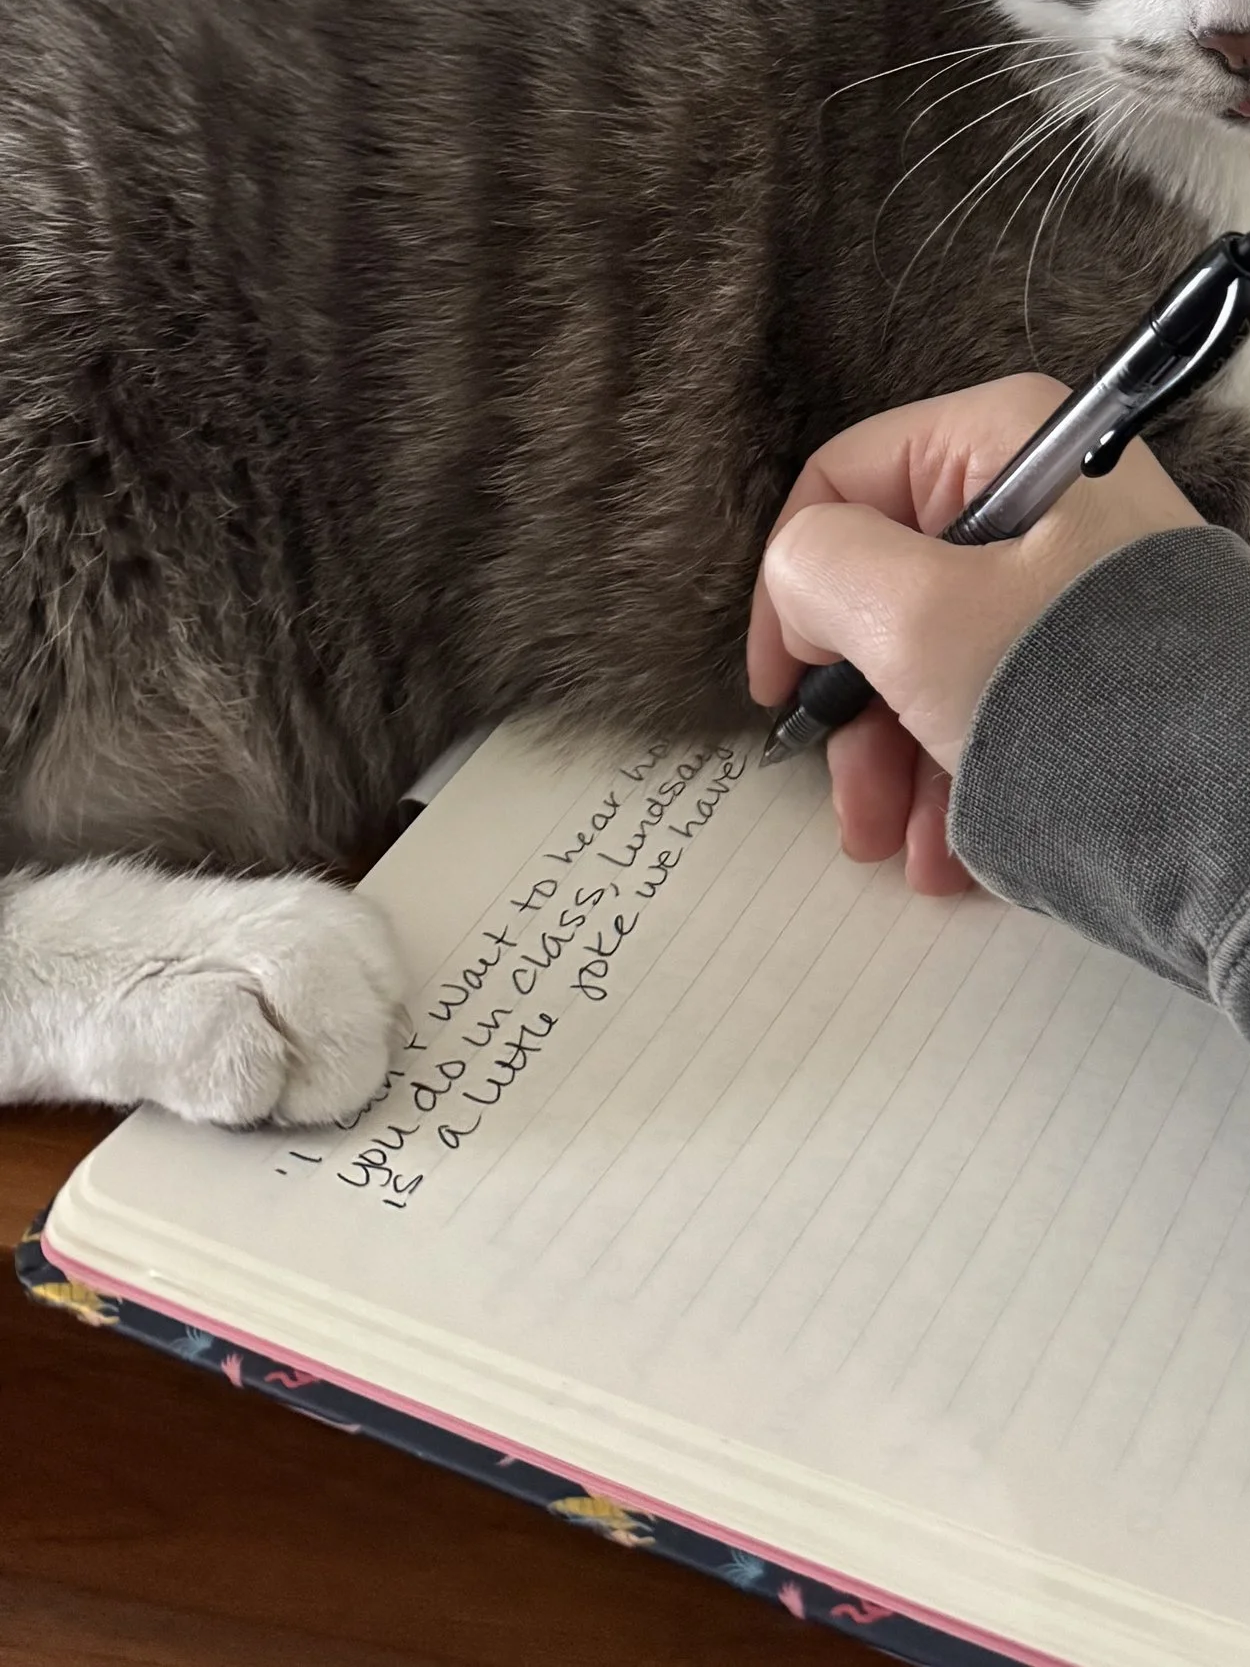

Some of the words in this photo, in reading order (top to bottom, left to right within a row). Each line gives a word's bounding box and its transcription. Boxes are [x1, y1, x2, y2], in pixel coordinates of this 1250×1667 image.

[383, 1174, 424, 1209] is
[438, 1113, 482, 1149] a
[462, 1013, 559, 1104] little
[570, 912, 640, 1001] joke
[635, 847, 684, 898] we
[669, 754, 748, 837] have
[510, 879, 558, 913] to
[543, 791, 621, 864] hear
[337, 1124, 421, 1187] you
[410, 1060, 466, 1111] do
[462, 1009, 513, 1047] in
[513, 883, 620, 995] class,
